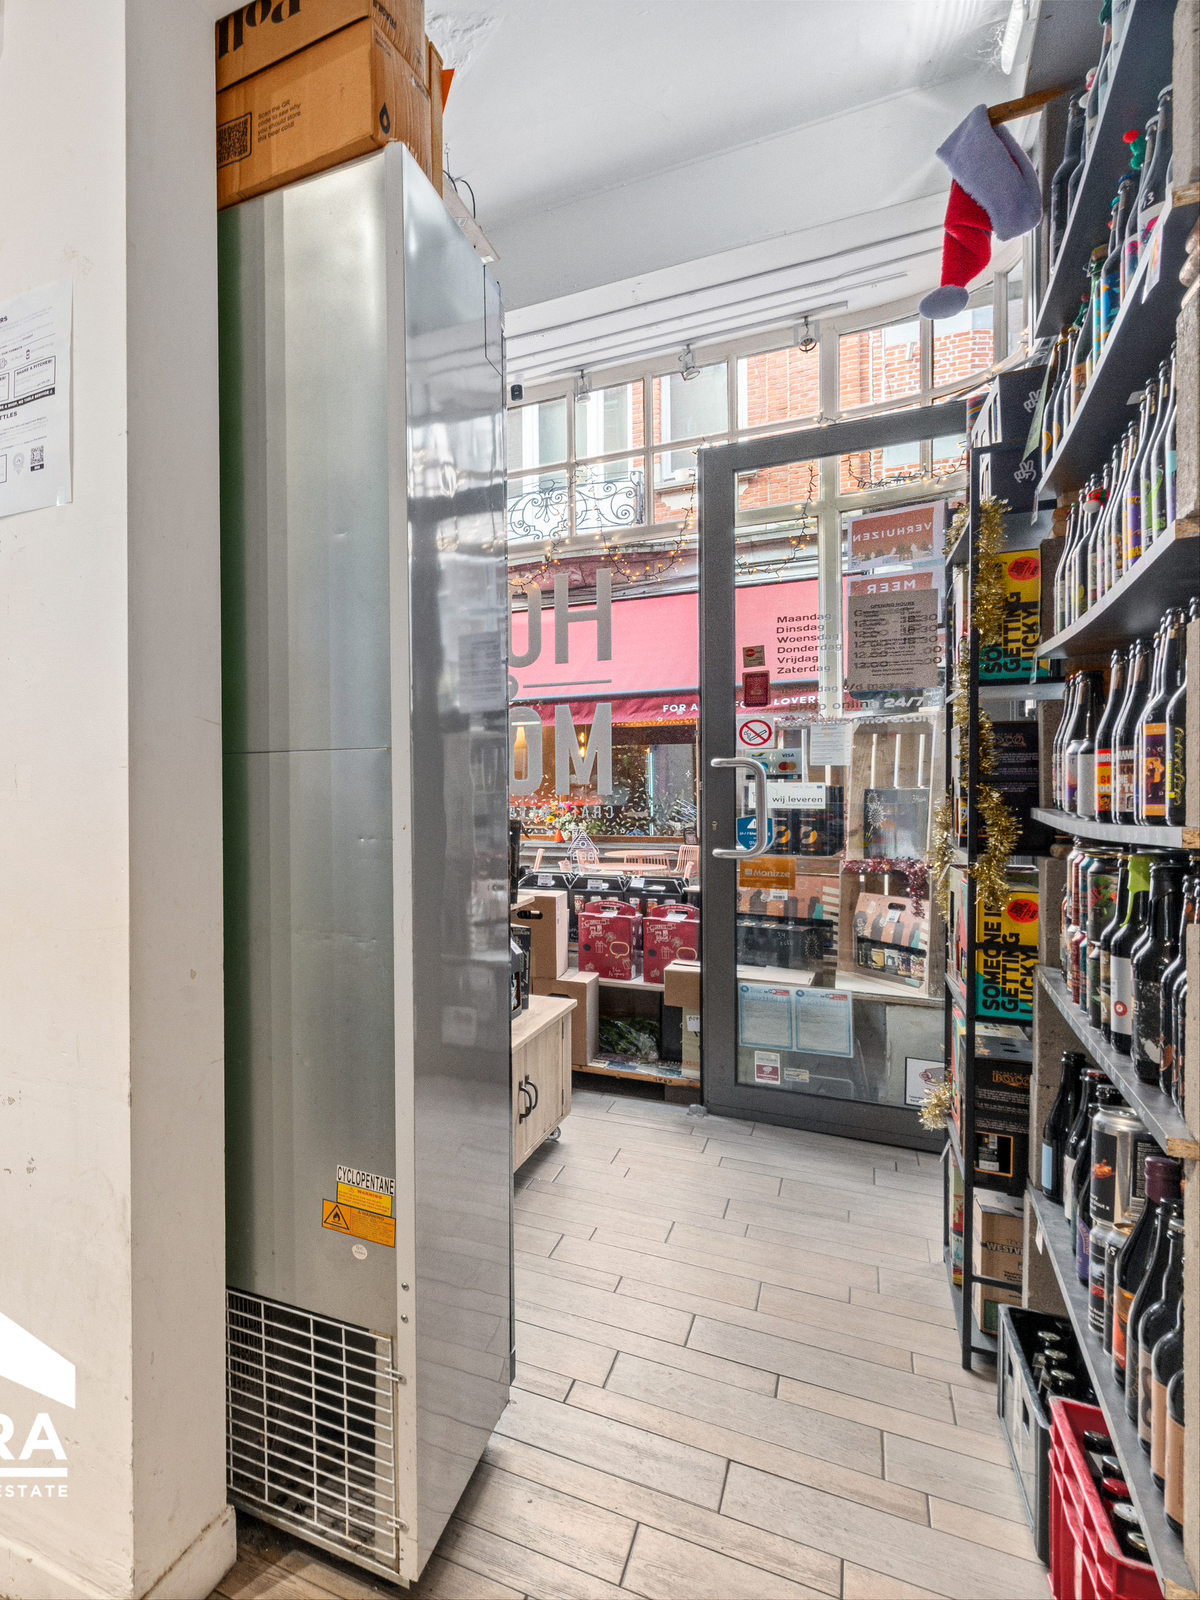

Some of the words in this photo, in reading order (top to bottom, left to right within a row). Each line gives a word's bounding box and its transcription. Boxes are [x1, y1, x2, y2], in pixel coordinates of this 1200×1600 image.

[258, 110, 271, 121] Scan
[272, 105, 280, 113] the
[282, 99, 290, 108] QR
[258, 117, 271, 128] code
[278, 109, 288, 117] see
[258, 126, 267, 136] you
[268, 117, 286, 130] should
[258, 134, 267, 143] this
[268, 128, 280, 139] beer
[777, 613, 831, 624] Maandag
[776, 624, 825, 634] Dinsdag
[777, 633, 839, 643] Woensdag
[777, 644, 842, 654] Donderdag
[777, 655, 819, 664] Vrijdag
[777, 665, 831, 674] Zaterdag
[772, 795, 786, 804] wij
[788, 795, 823, 803] leveren
[753, 869, 790, 878] Monizze
[982, 921, 1001, 1012] SOMEONE
[1001, 932, 1020, 1013] GETTING
[337, 1166, 394, 1195] CYCLOPENTANE
[357, 1189, 382, 1200] WARNING
